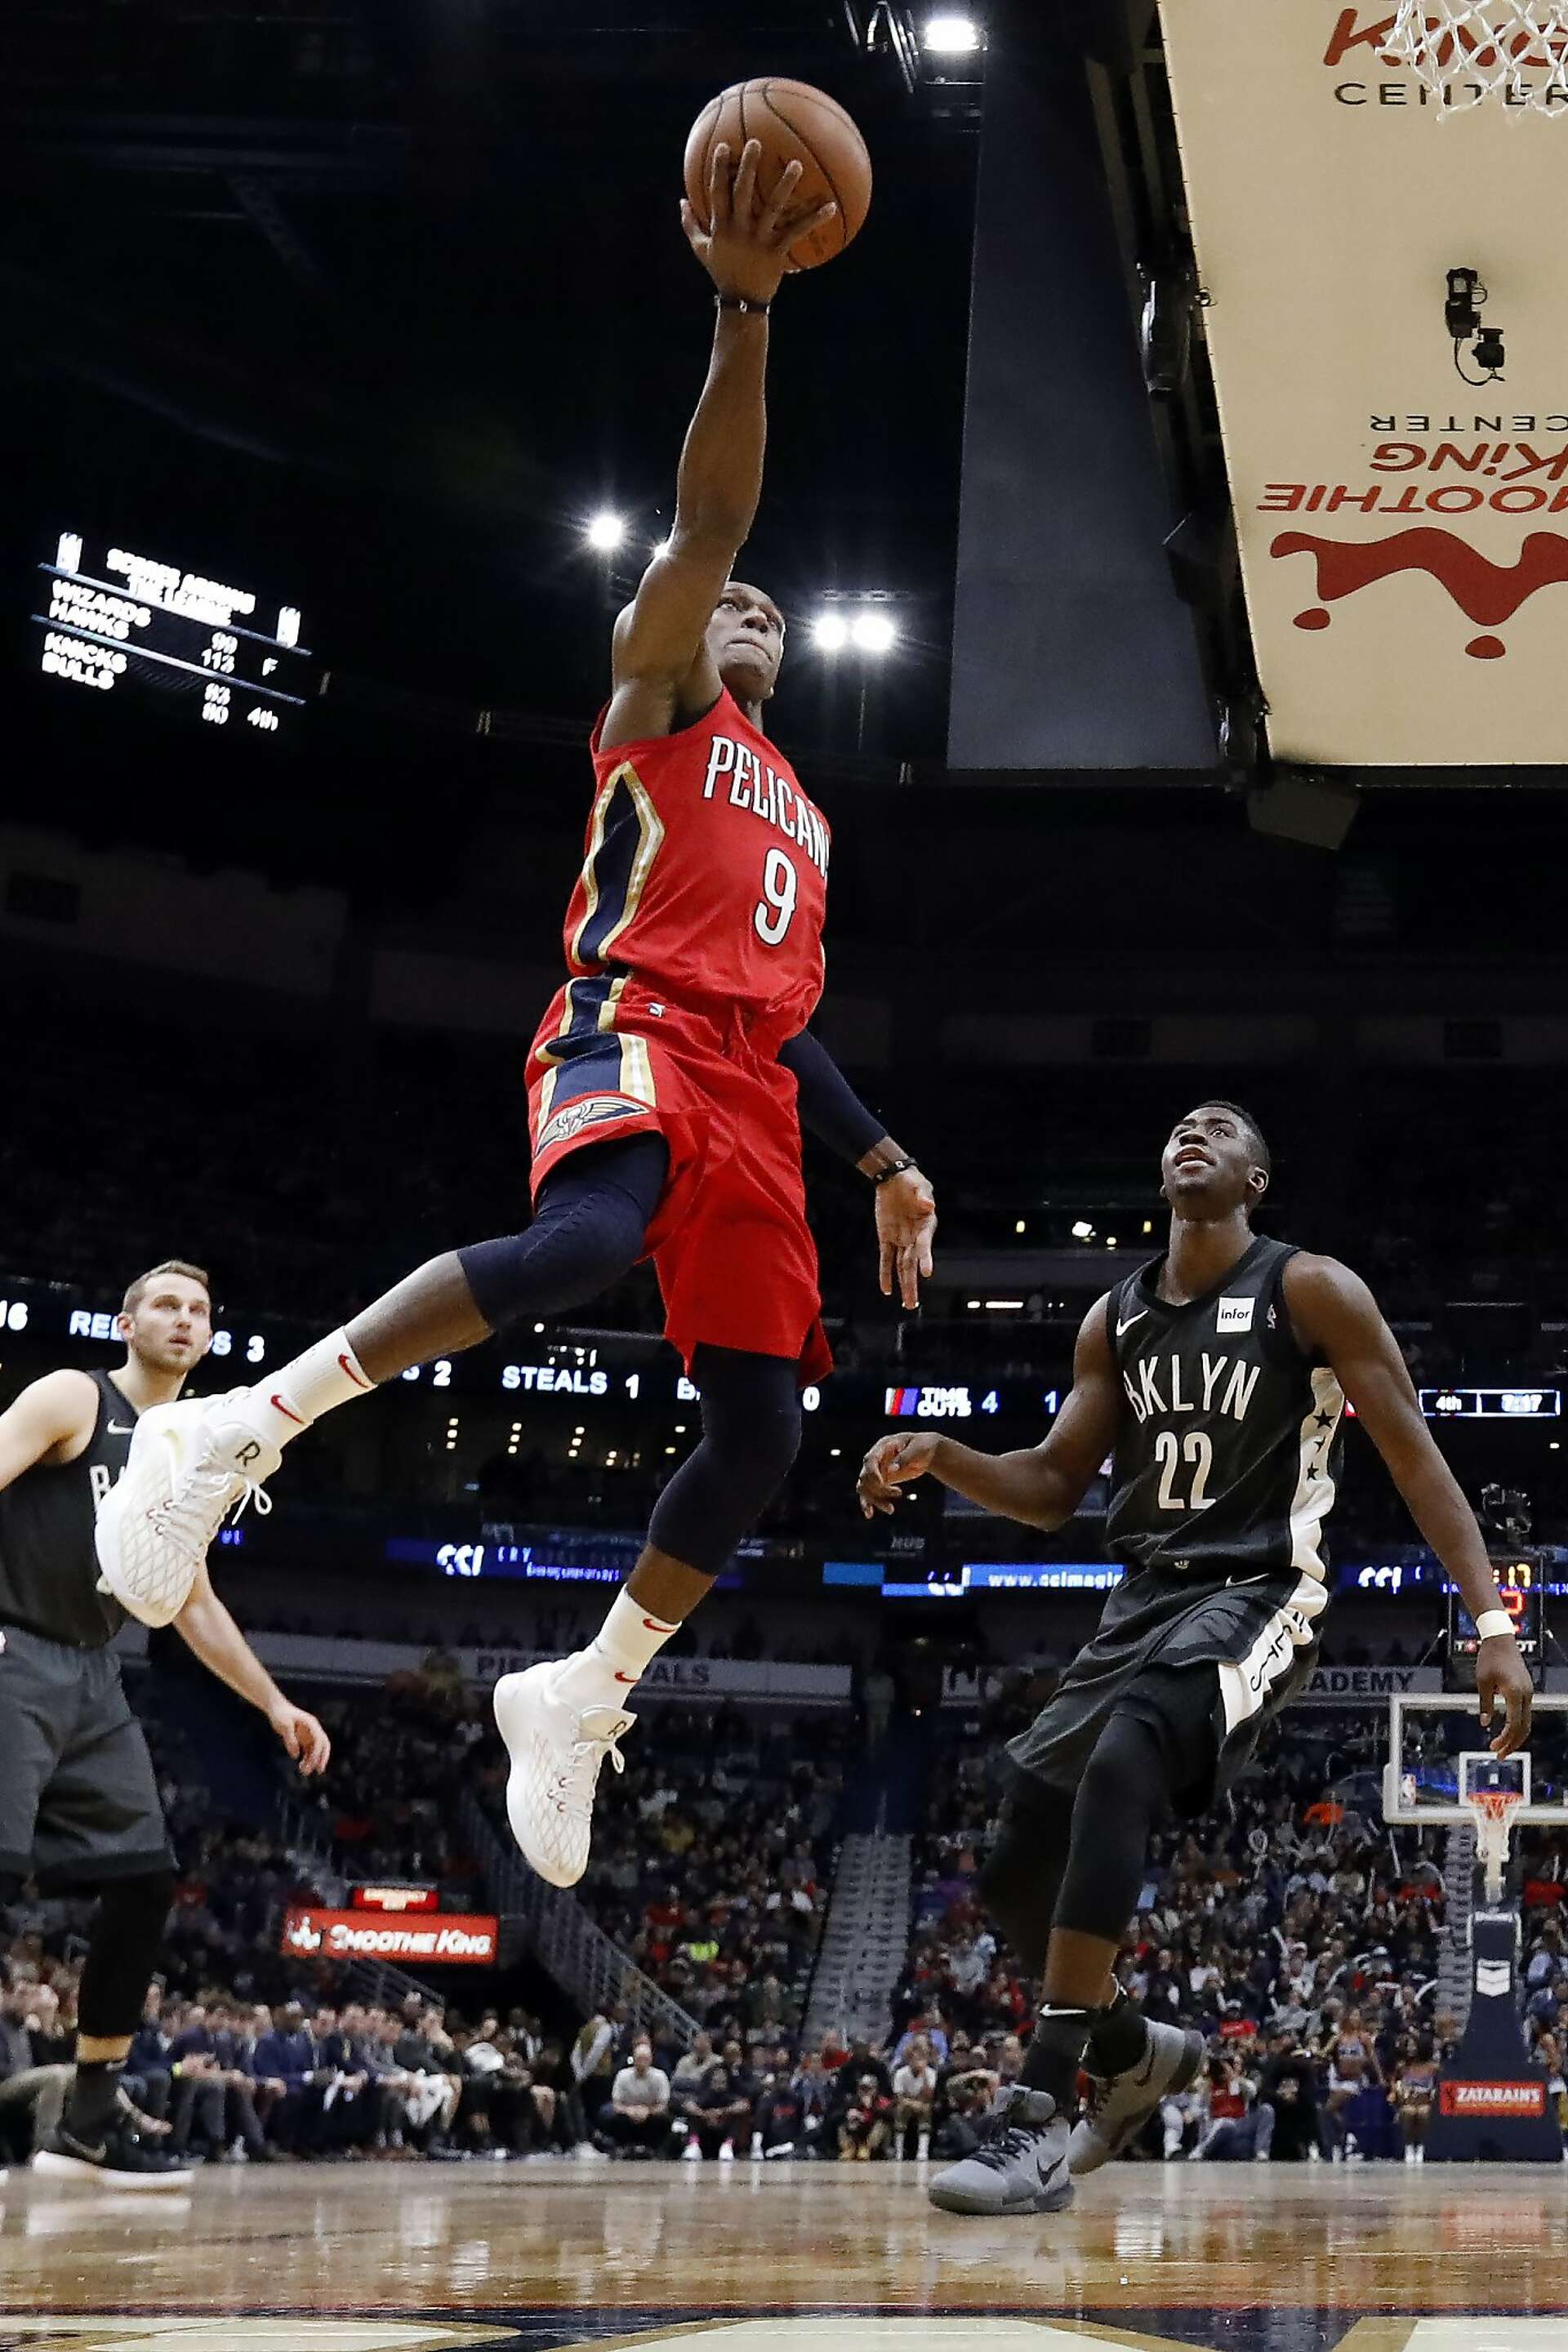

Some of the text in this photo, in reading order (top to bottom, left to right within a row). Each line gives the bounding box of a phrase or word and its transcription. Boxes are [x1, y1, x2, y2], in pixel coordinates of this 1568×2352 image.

[1370, 415, 1568, 432] CENTER
[52, 579, 152, 628] WIZARDS
[754, 847, 796, 946] 9
[1221, 1308, 1250, 1320] infor
[247, 1335, 265, 1362] 3
[434, 1360, 452, 1387] 2
[501, 1365, 639, 1399] STEALS 1
[802, 1386, 820, 1411] 0
[981, 1391, 999, 1414] 4
[1435, 1395, 1463, 1411] 4th
[1155, 1431, 1217, 1510] 22
[1491, 1562, 1531, 1588] :17
[1308, 1671, 1415, 1693] ADEMY
